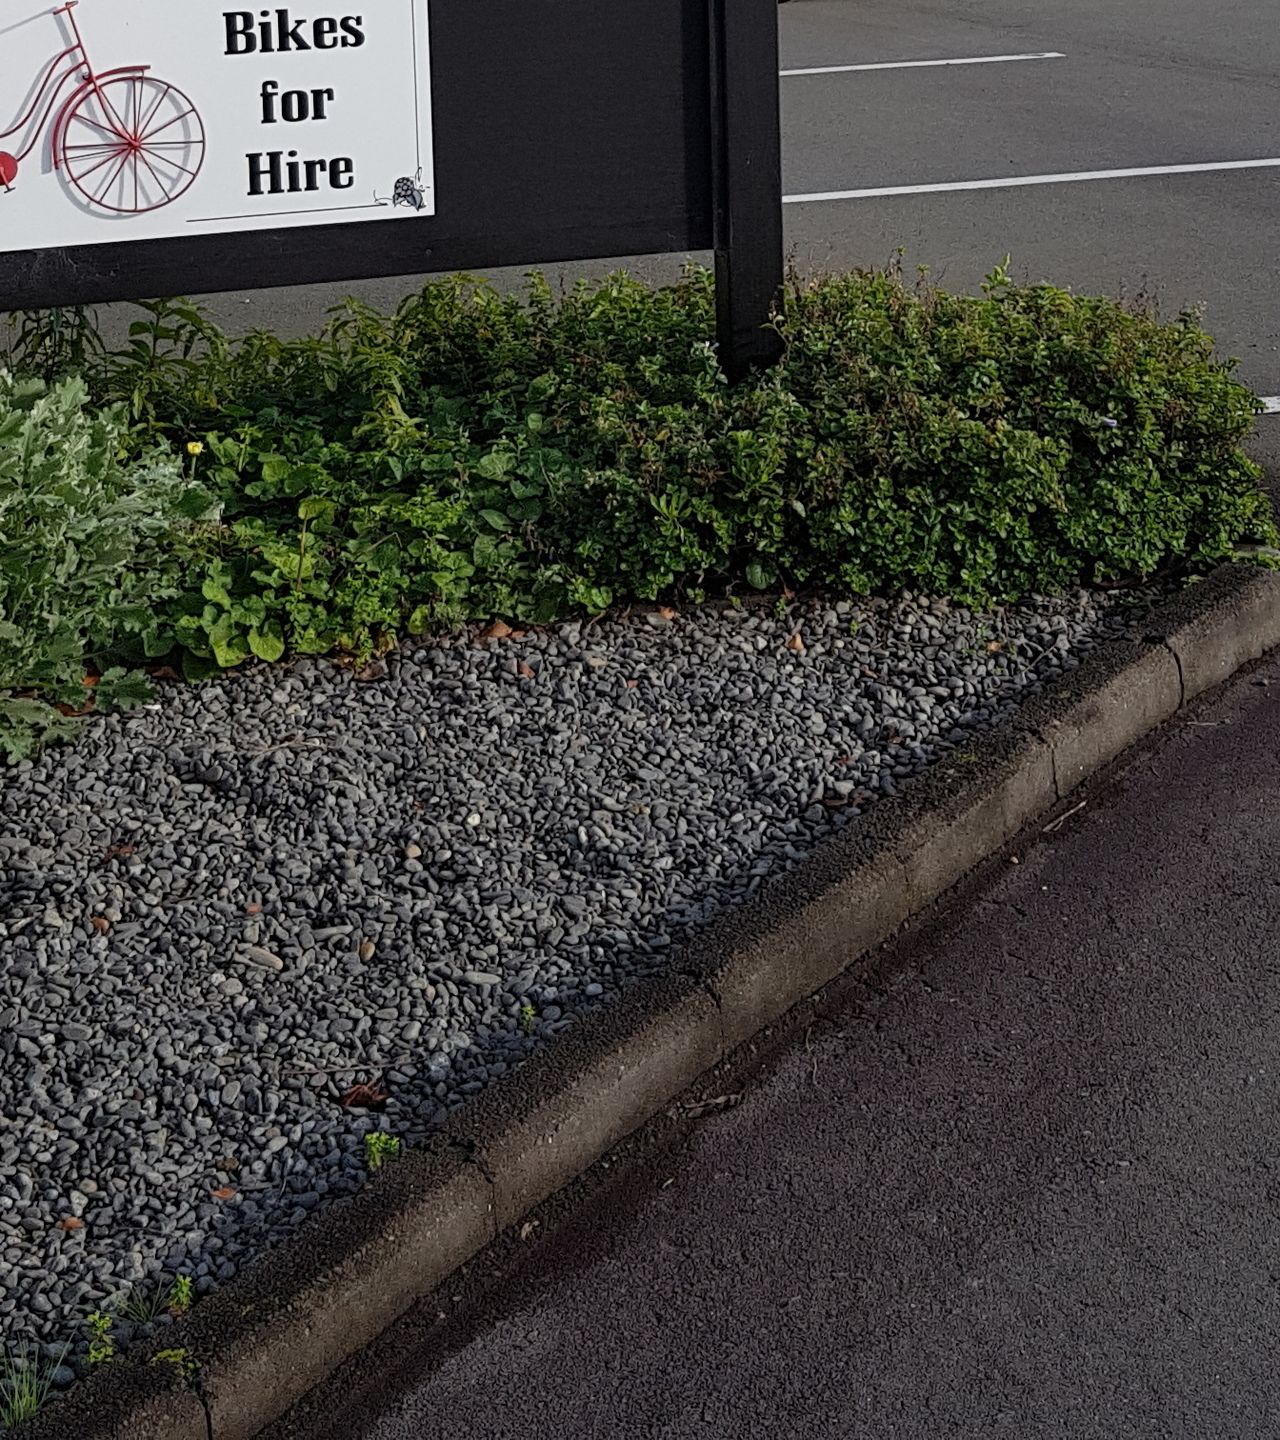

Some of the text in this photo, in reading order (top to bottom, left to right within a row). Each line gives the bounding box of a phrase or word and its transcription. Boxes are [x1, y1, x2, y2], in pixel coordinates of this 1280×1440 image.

[222, 9, 365, 55] Bikes
[260, 80, 334, 124] for
[246, 150, 354, 196] Hire
